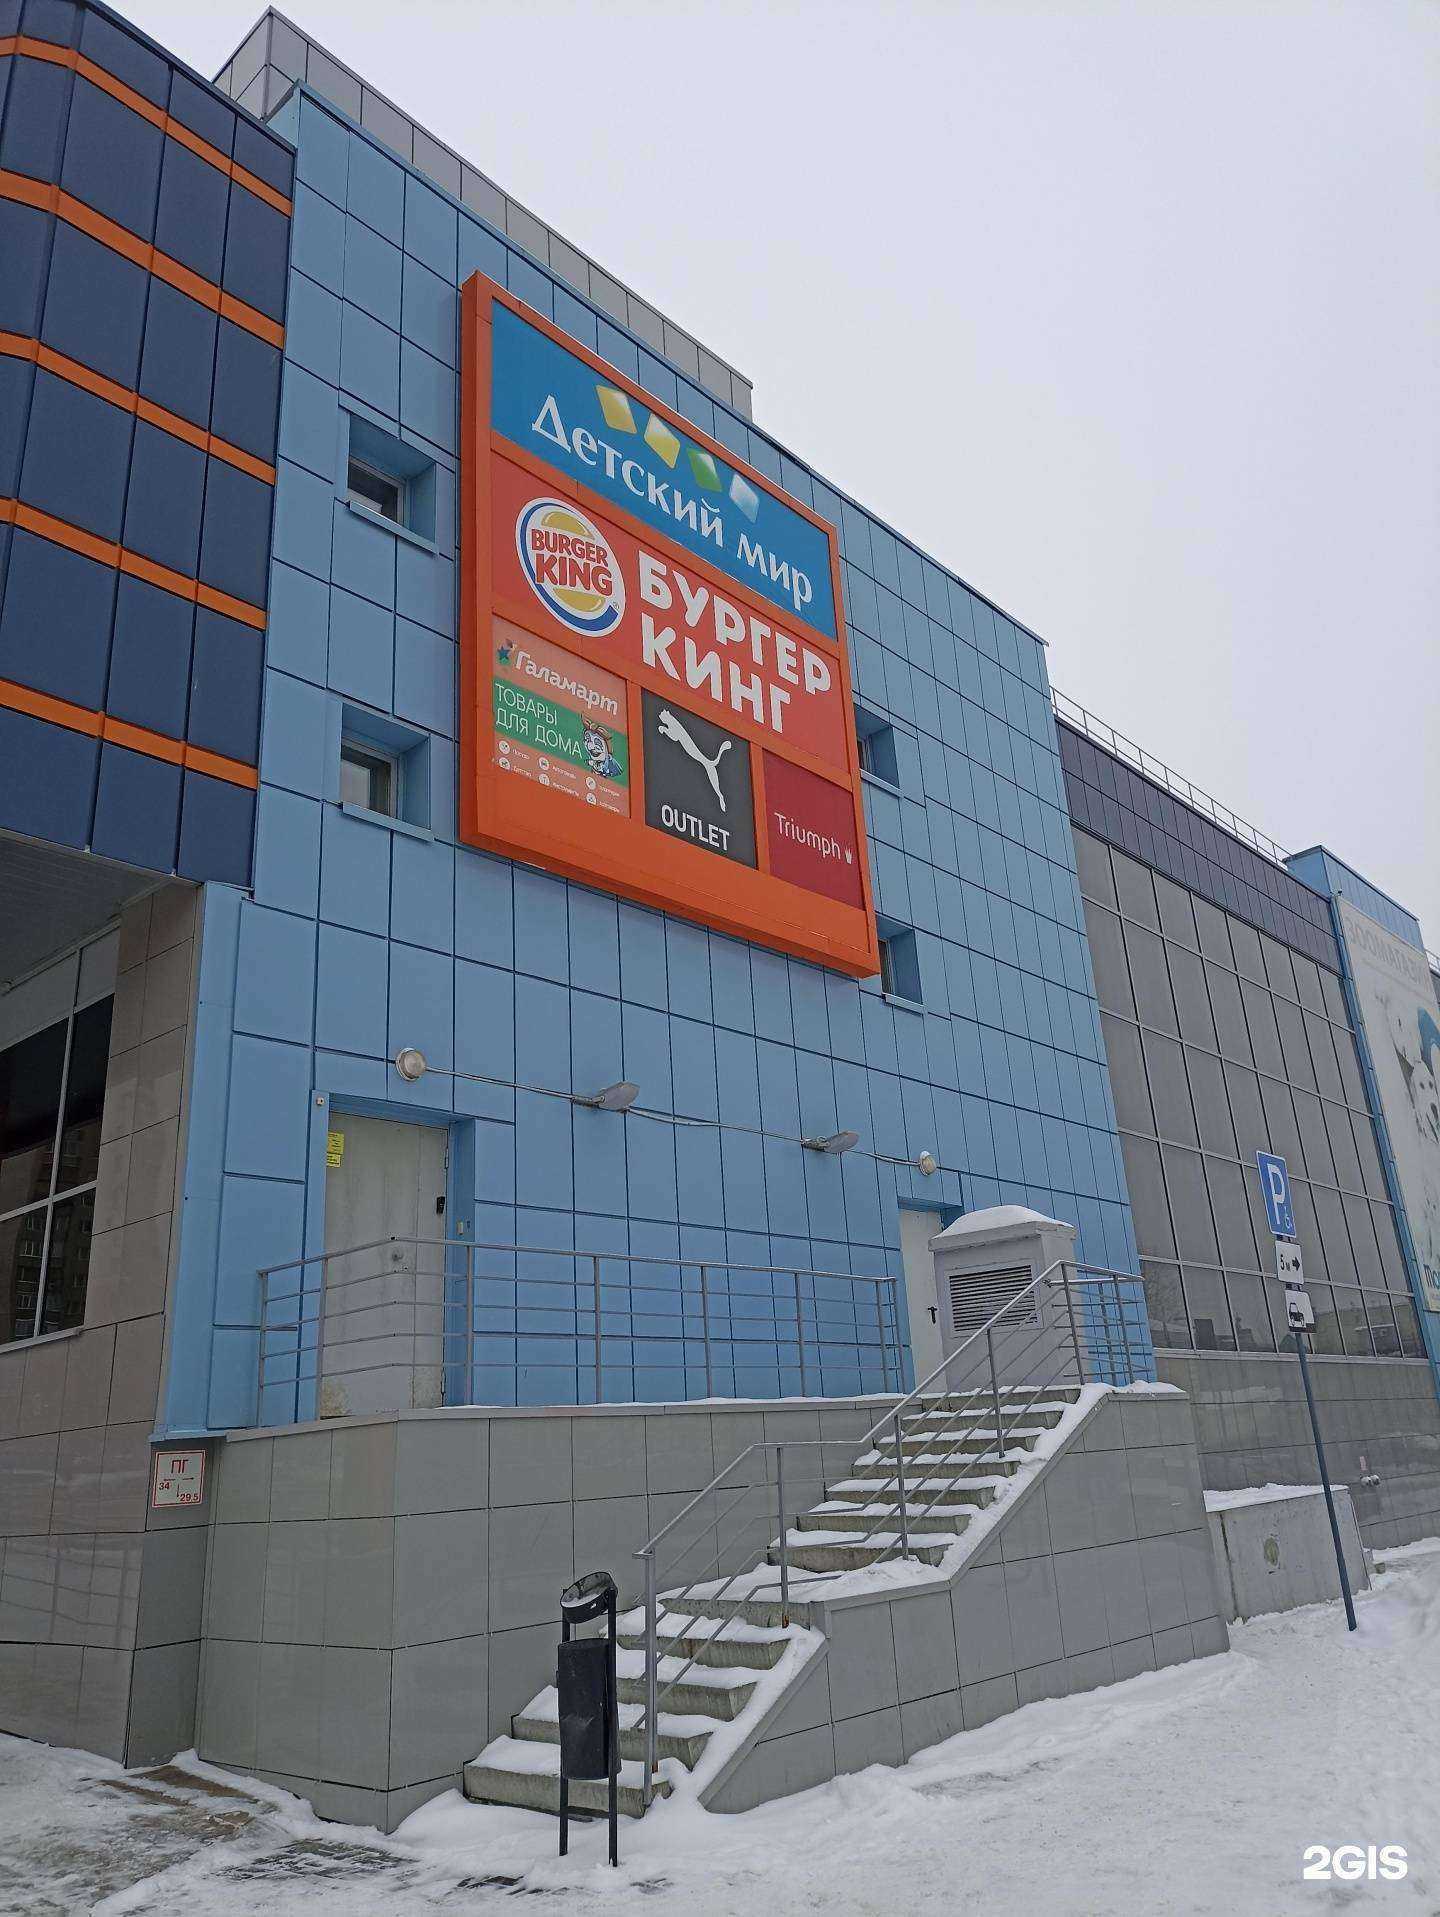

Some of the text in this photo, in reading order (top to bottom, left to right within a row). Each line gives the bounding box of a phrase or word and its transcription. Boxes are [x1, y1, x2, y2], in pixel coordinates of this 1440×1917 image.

[531, 395, 813, 612] Детский мир
[531, 528, 608, 567] BURGER
[535, 553, 613, 597] KING
[638, 550, 832, 695] БУРГЕР
[514, 651, 618, 715] Галамарт
[641, 612, 791, 734] КИНГ
[495, 683, 558, 726] ТОВАРЫ
[496, 707, 583, 759] ДЛЯ ДОМА
[661, 804, 730, 851] OUTLET
[774, 812, 841, 860] Triumph
[1267, 1163, 1286, 1225] P
[159, 1482, 170, 1490] 34
[171, 1459, 189, 1473] ПГ
